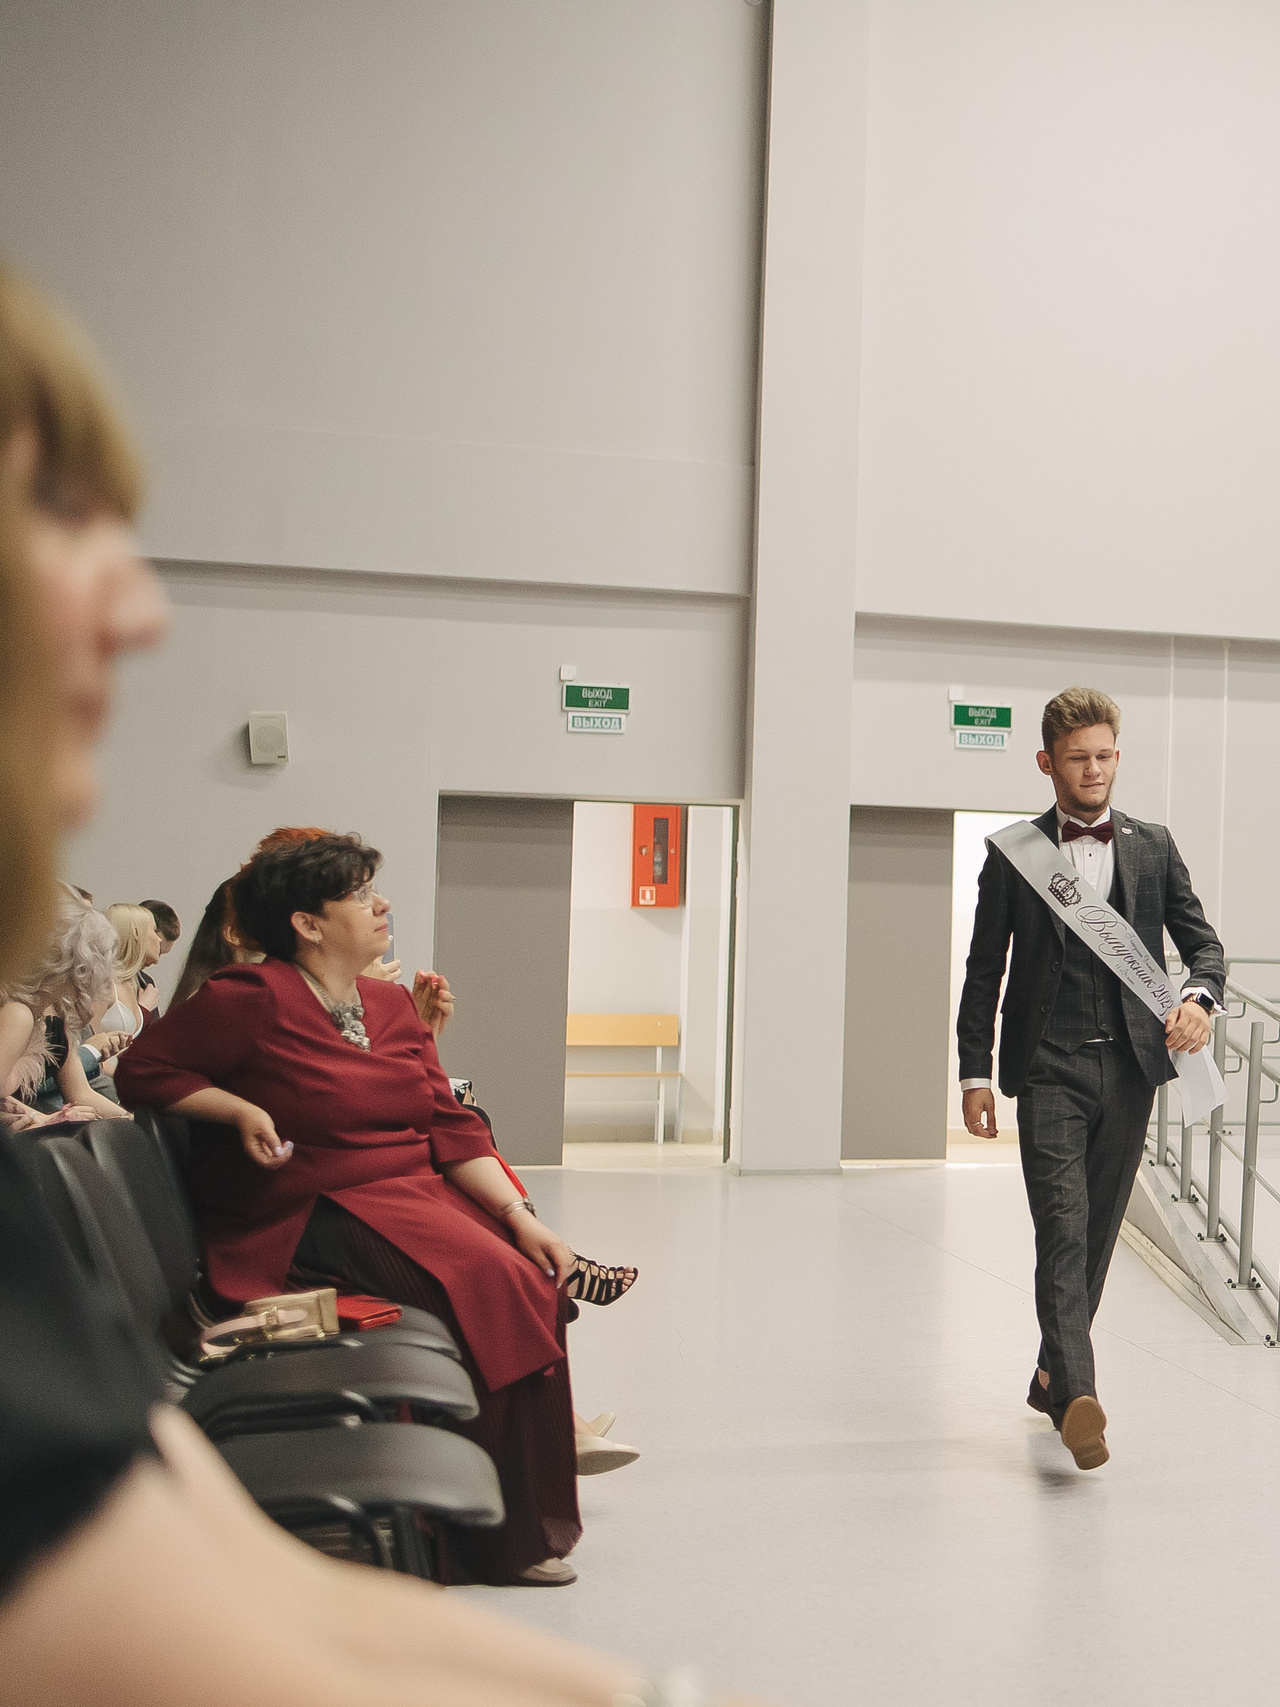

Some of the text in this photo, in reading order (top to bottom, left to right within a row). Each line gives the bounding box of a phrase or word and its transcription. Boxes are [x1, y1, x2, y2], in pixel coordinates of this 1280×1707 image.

[582, 688, 613, 700] ВЫХОД
[588, 699, 608, 708] EXIT
[968, 707, 997, 719] ВЫХОД
[573, 717, 620, 730] ВЫХОД
[974, 718, 992, 726] EXIT
[961, 734, 1003, 747] ВЫХОД
[1075, 905, 1157, 989] Выпускник
[1150, 983, 1175, 1017] 2023
